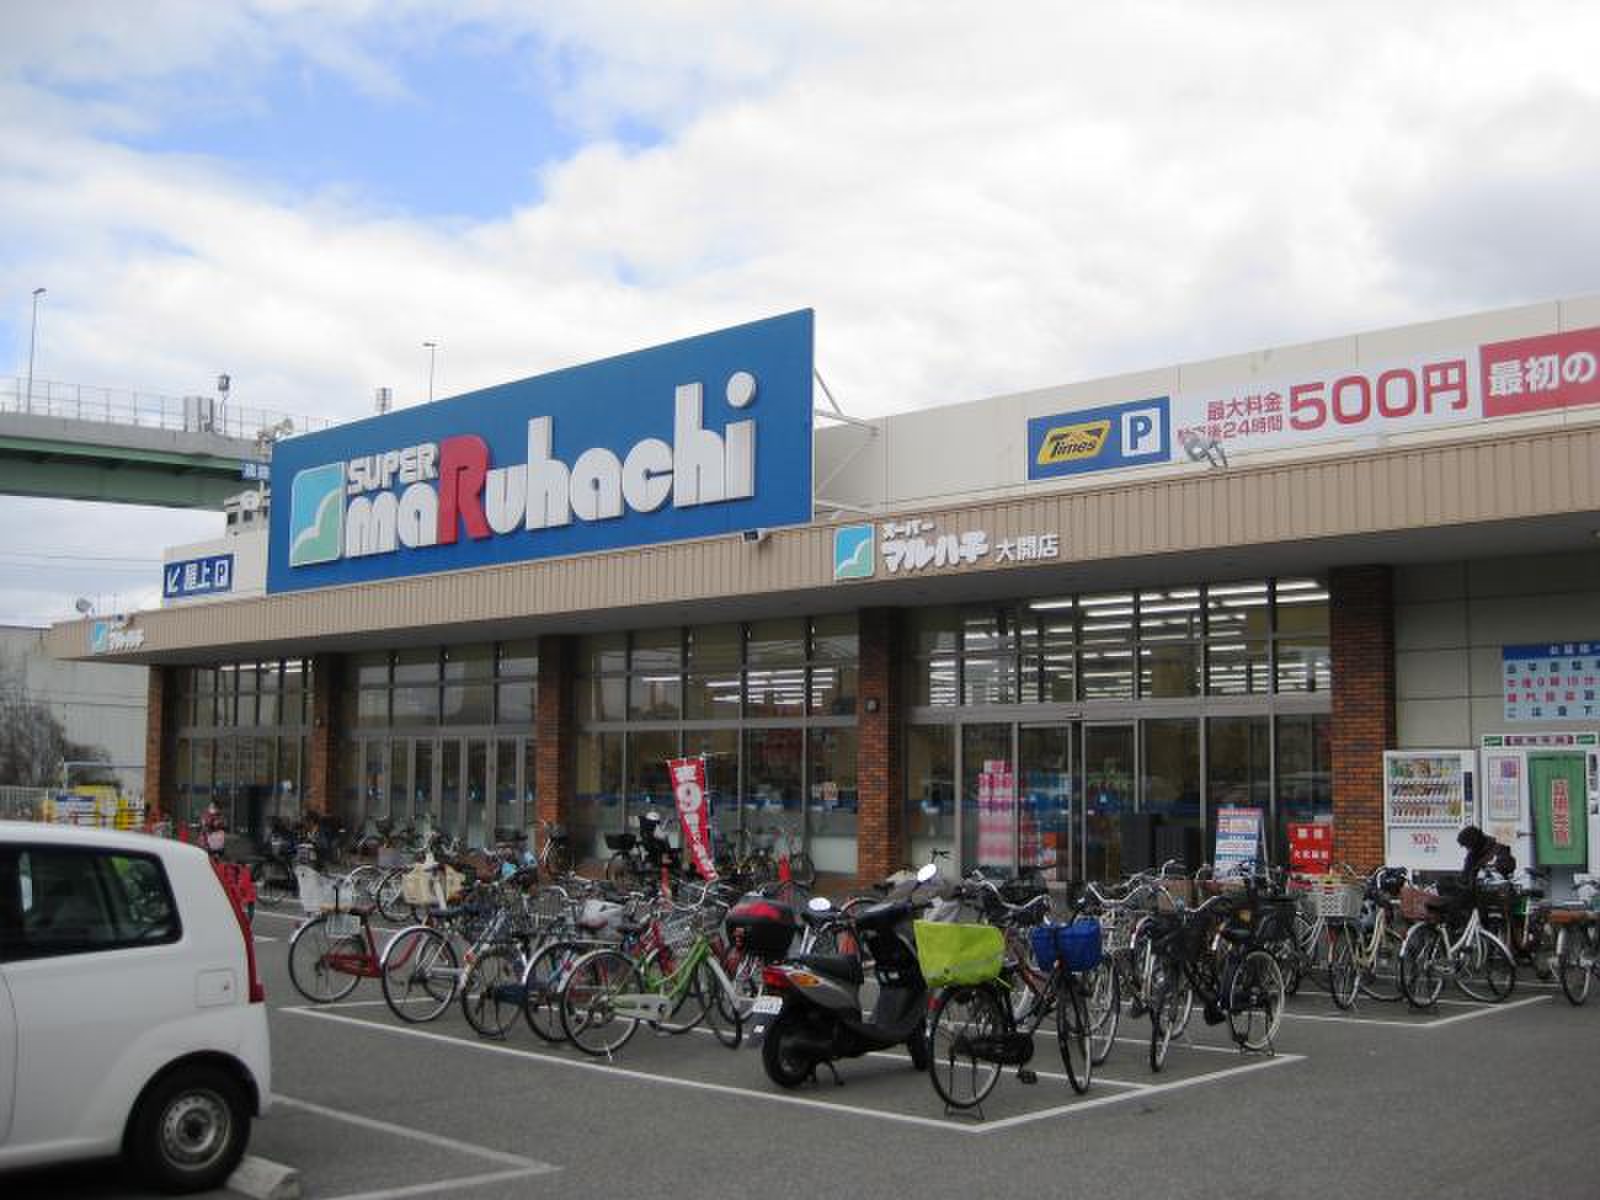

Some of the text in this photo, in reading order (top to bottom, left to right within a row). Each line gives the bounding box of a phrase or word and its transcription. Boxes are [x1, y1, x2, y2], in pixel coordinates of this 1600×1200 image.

[1288, 358, 1470, 432] 500円
[1489, 350, 1597, 398] 最初の
[1178, 414, 1283, 445] 後24時間
[1207, 391, 1282, 422] 最大料金
[1050, 416, 1153, 459] Times P
[344, 371, 756, 558] maRuhachi
[347, 442, 438, 495] SUPER
[881, 529, 1060, 573] マルハチ 大開店
